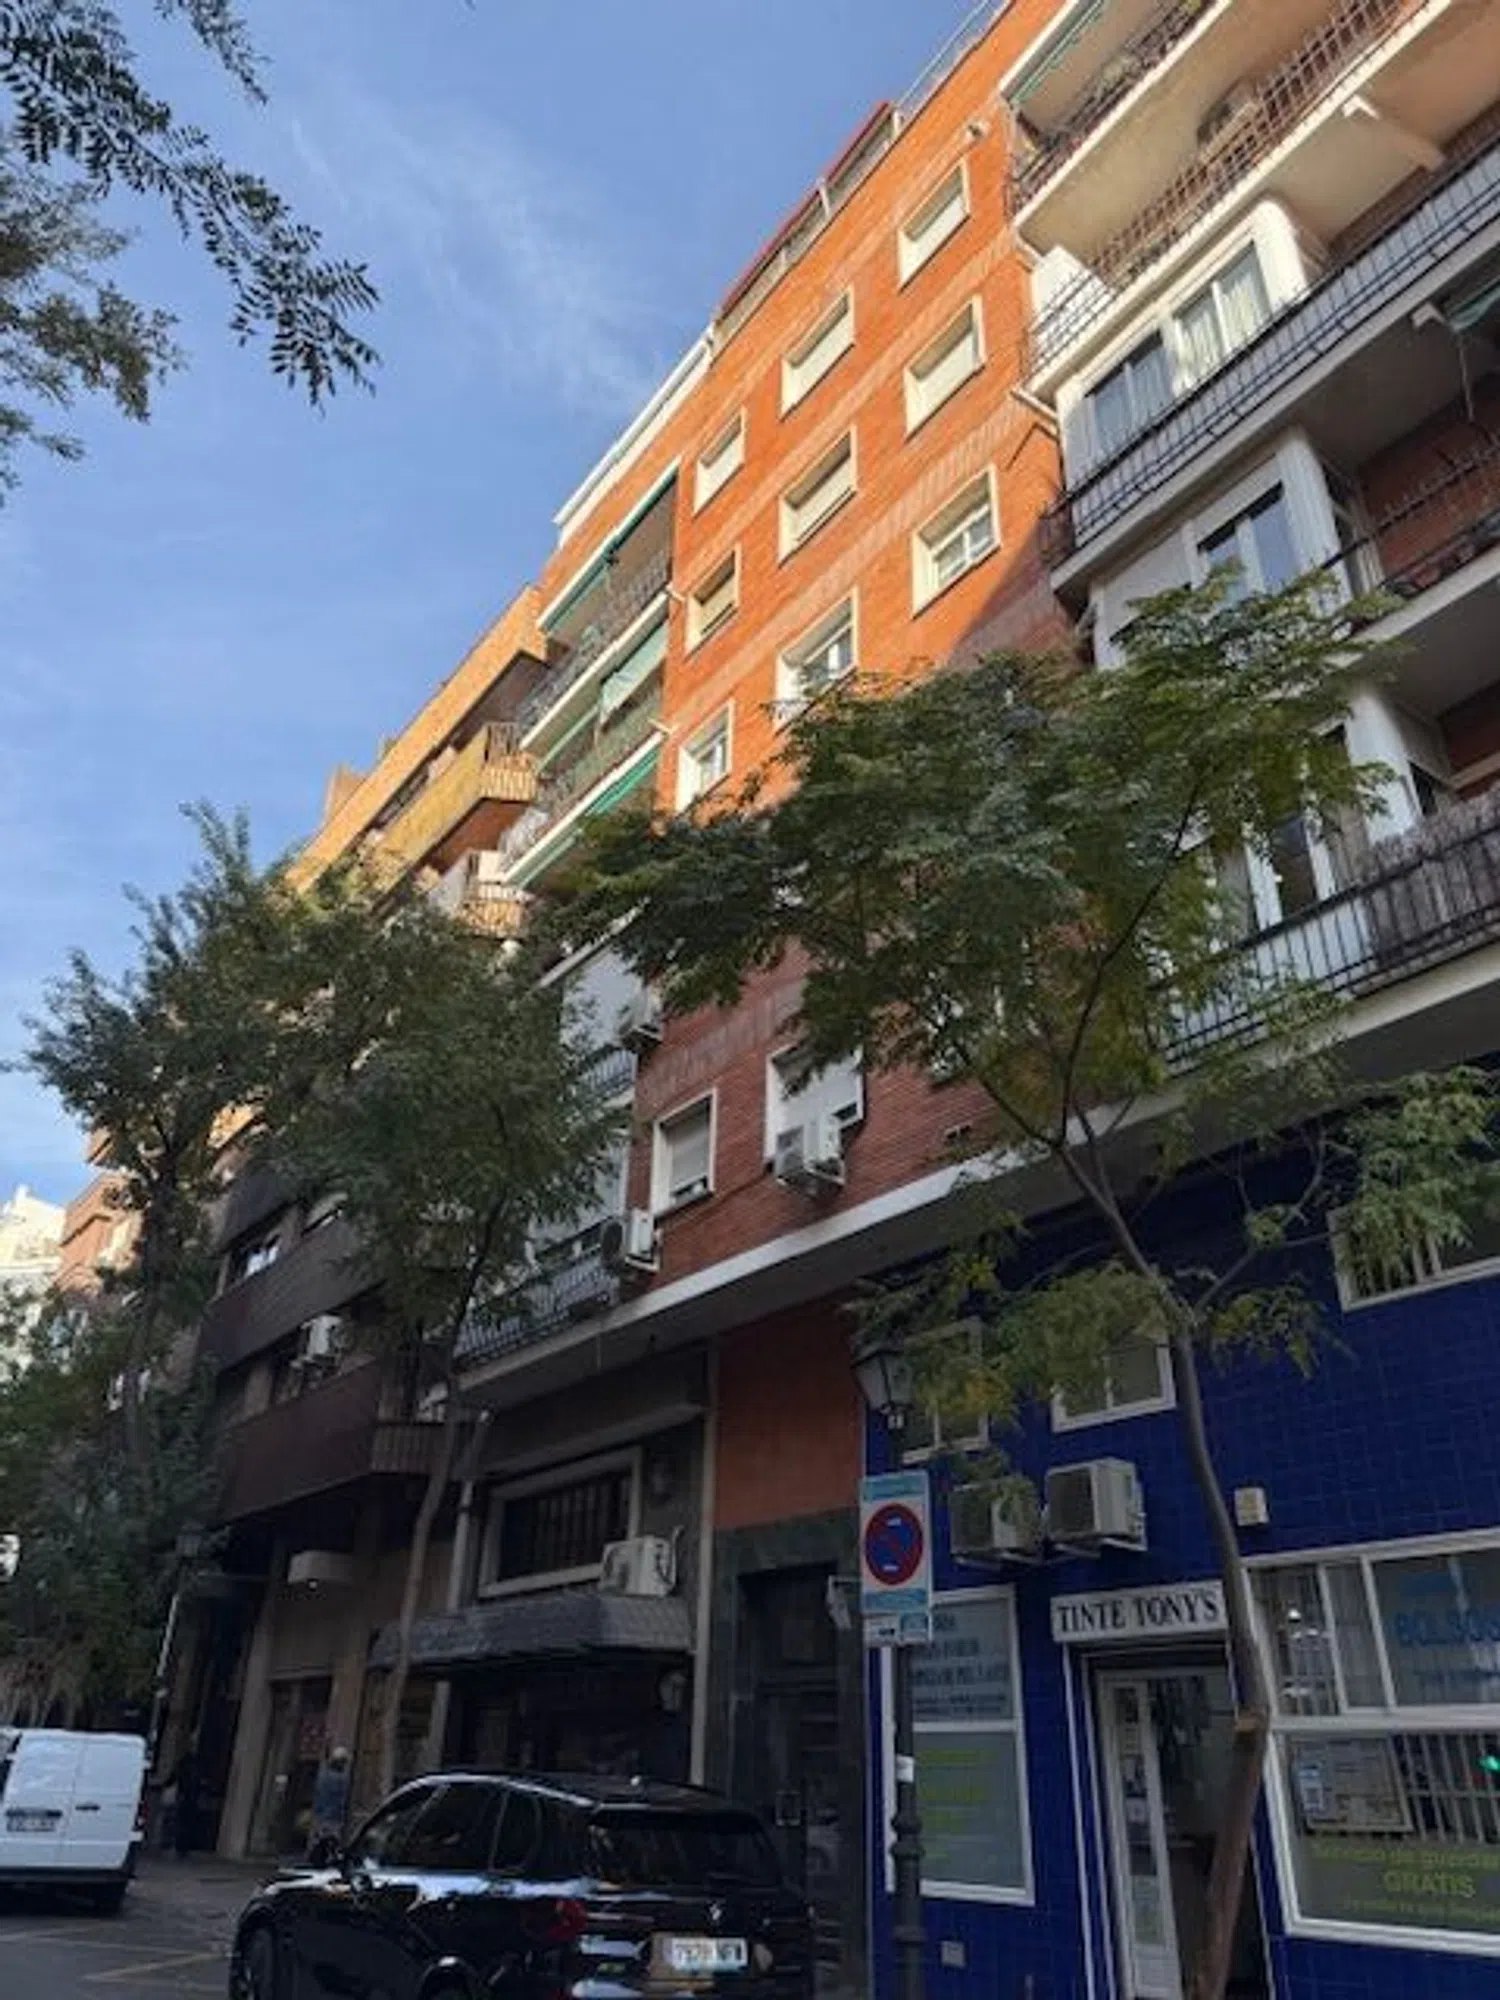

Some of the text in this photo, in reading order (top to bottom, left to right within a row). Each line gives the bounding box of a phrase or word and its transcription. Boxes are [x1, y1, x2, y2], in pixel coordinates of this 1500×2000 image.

[1057, 1588, 1219, 1632] TINTE TONY'S
[1383, 1871, 1476, 1898] GRATIS
